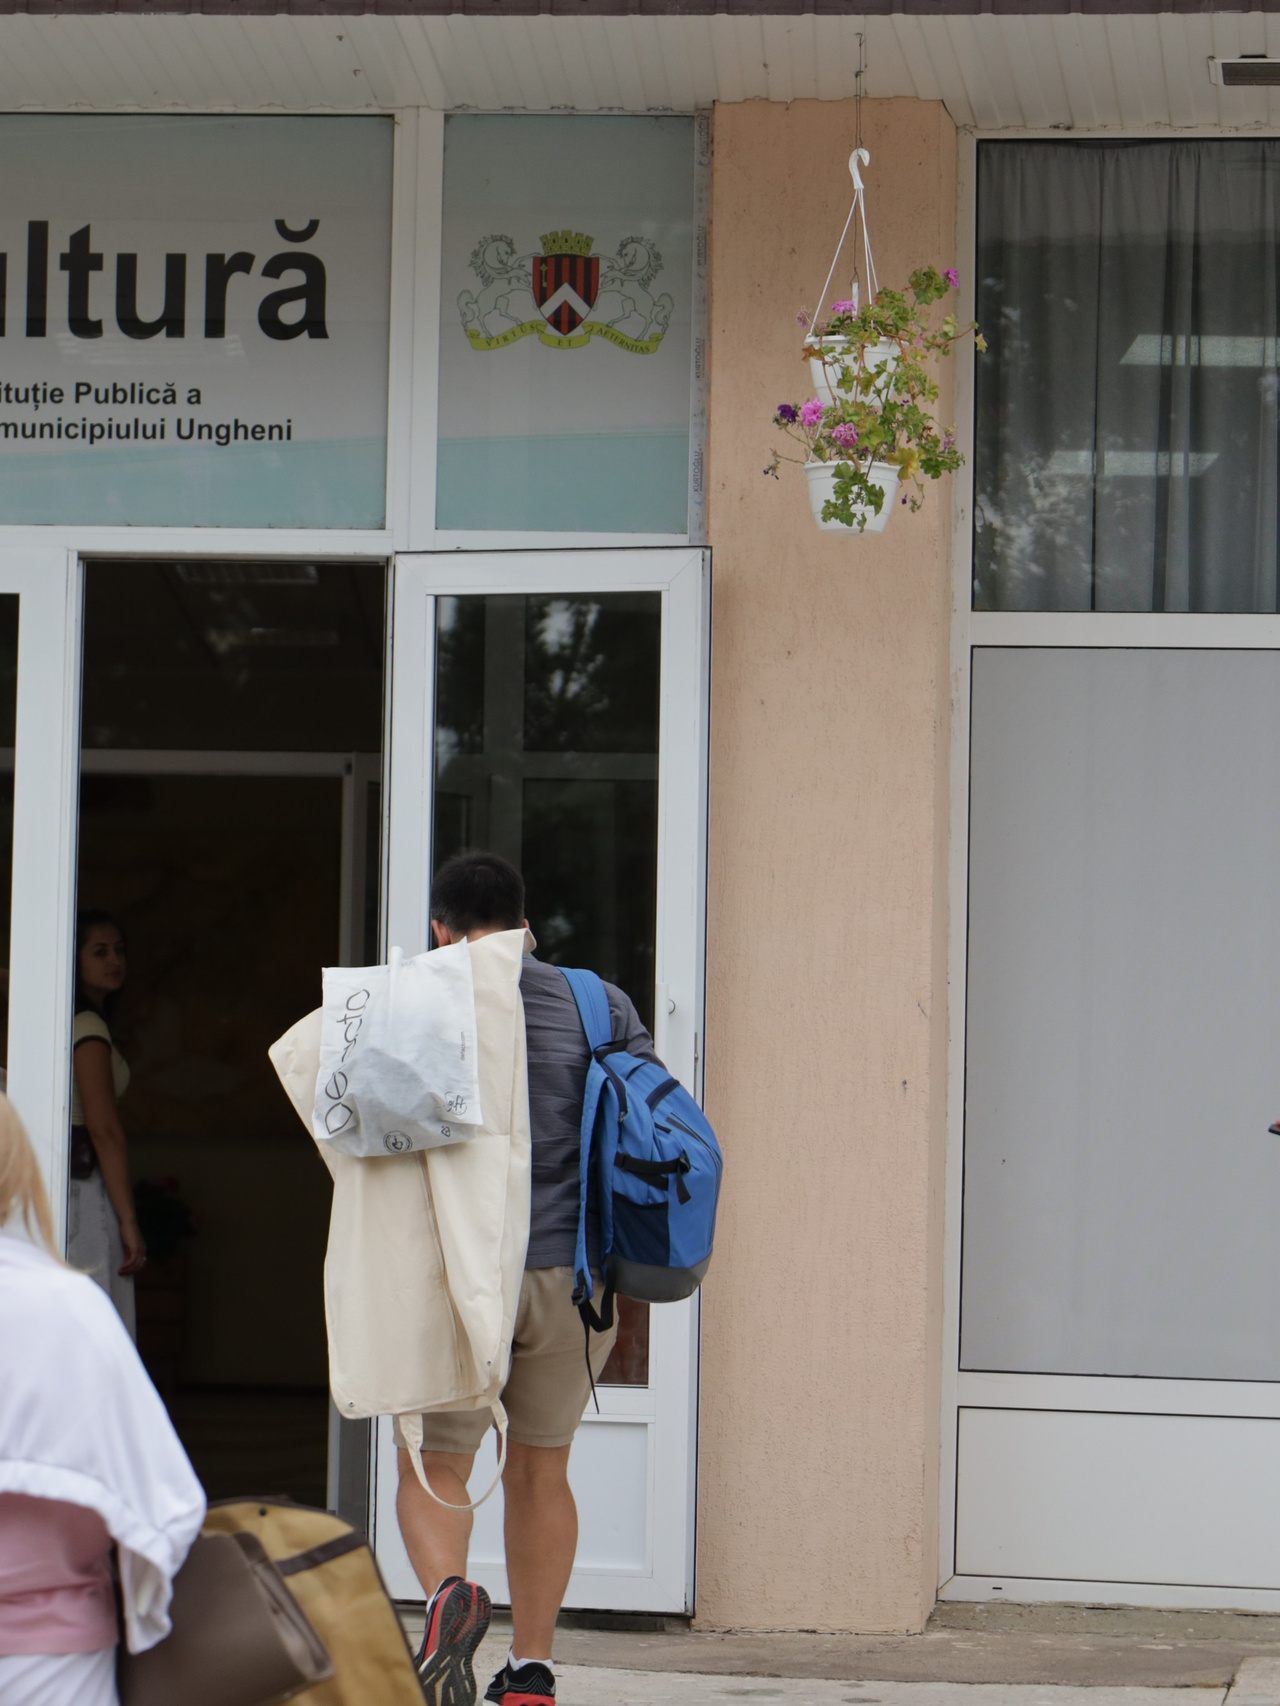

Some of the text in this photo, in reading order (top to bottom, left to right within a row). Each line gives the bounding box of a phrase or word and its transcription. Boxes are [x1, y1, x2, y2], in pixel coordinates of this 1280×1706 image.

[485, 324, 537, 348] VIRTUS
[557, 338, 573, 347] ET
[76, 382, 177, 405] Publică
[187, 389, 201, 404] a
[177, 419, 292, 447] Ungheni
